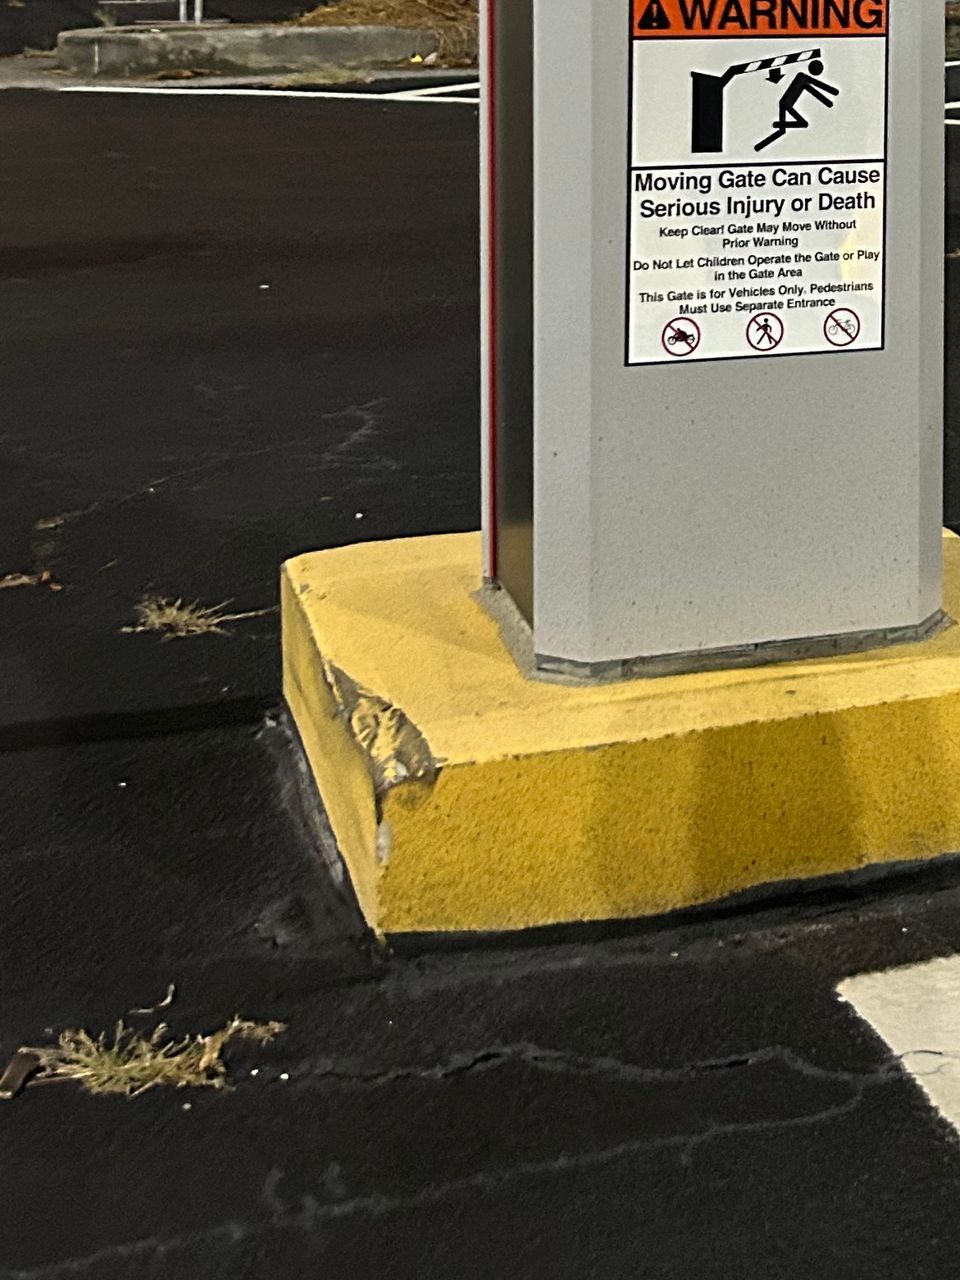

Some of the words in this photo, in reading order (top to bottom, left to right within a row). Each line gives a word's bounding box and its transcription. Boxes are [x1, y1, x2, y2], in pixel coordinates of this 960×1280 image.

[635, 172, 712, 194] Moving
[718, 170, 766, 190] Gate
[772, 168, 811, 187] Can
[818, 167, 880, 185] Cause
[640, 199, 720, 218] Serious
[727, 195, 785, 218] Injury
[791, 196, 812, 212] or
[818, 192, 875, 210] Death
[659, 227, 688, 239] Keep
[728, 224, 754, 234] Gate
[756, 223, 779, 235] May
[782, 221, 812, 232] Move
[814, 219, 857, 231] Without
[723, 238, 750, 248] Prior
[753, 236, 798, 248] Warning
[633, 261, 649, 270] Do
[653, 259, 672, 270] Not
[676, 258, 694, 268] Let
[697, 256, 745, 268] Children
[747, 254, 791, 266] Operate
[794, 252, 811, 263] the
[814, 251, 840, 262] Gate
[842, 252, 854, 261] or
[857, 250, 880, 262] Play
[714, 271, 725, 281] in
[728, 270, 746, 280] the
[748, 268, 774, 279] Gate
[777, 267, 803, 278] Area
[639, 291, 664, 303] This
[667, 290, 693, 302] Gate
[696, 289, 707, 300] is
[709, 288, 726, 299] for
[728, 286, 775, 298] Vehicles
[810, 281, 874, 293] Pedestrians
[679, 303, 707, 315] Must
[711, 302, 732, 313] Use
[735, 300, 784, 313] Separate
[787, 298, 835, 309] Entrance
